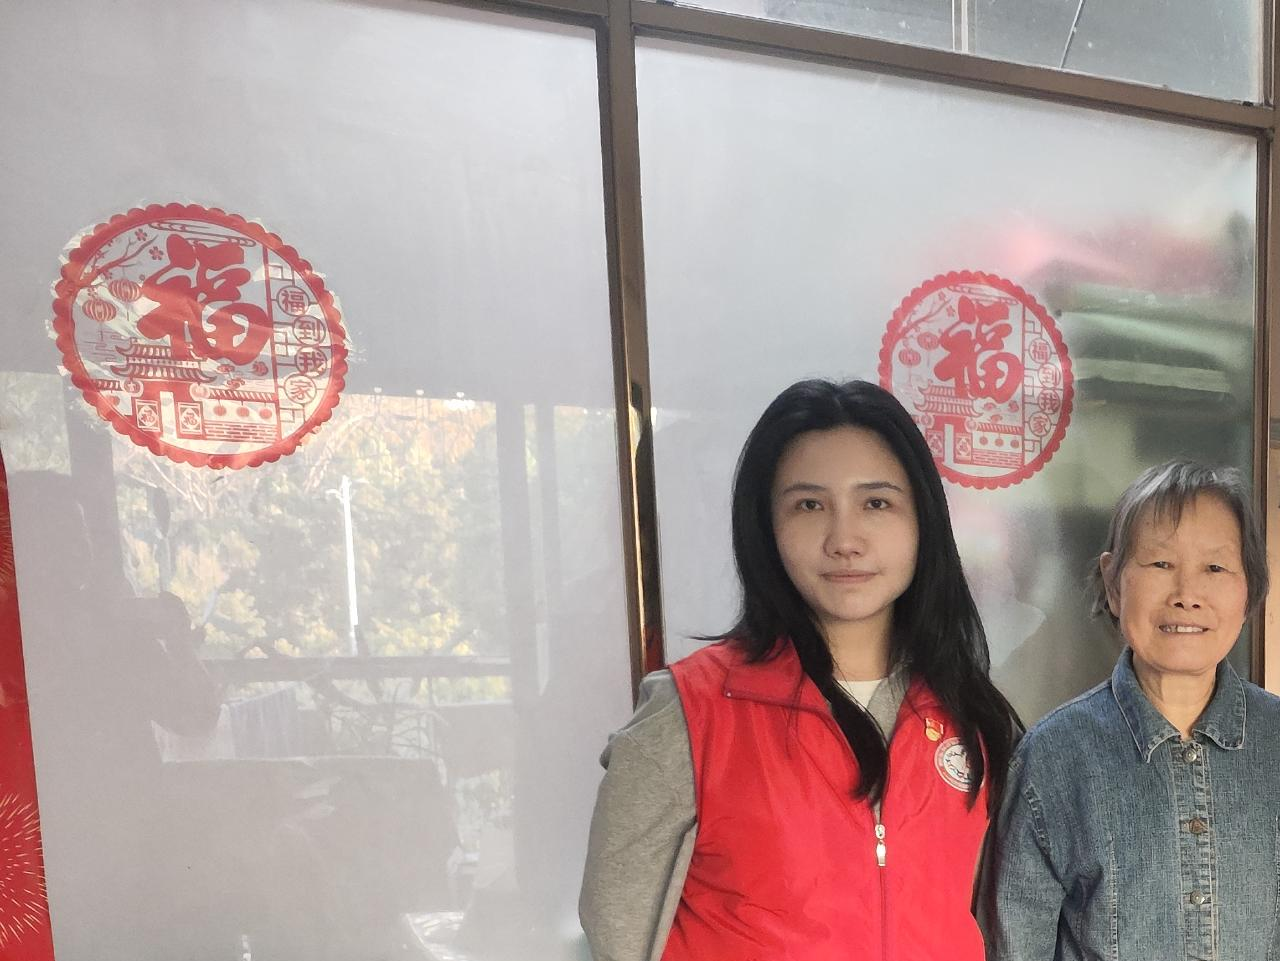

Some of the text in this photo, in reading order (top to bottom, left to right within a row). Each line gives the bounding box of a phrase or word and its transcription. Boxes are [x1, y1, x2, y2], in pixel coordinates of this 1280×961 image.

[138, 233, 273, 366] 福
[281, 289, 325, 400] 福到我家
[934, 295, 1024, 403] 福
[1032, 341, 1060, 434] 福到我家
